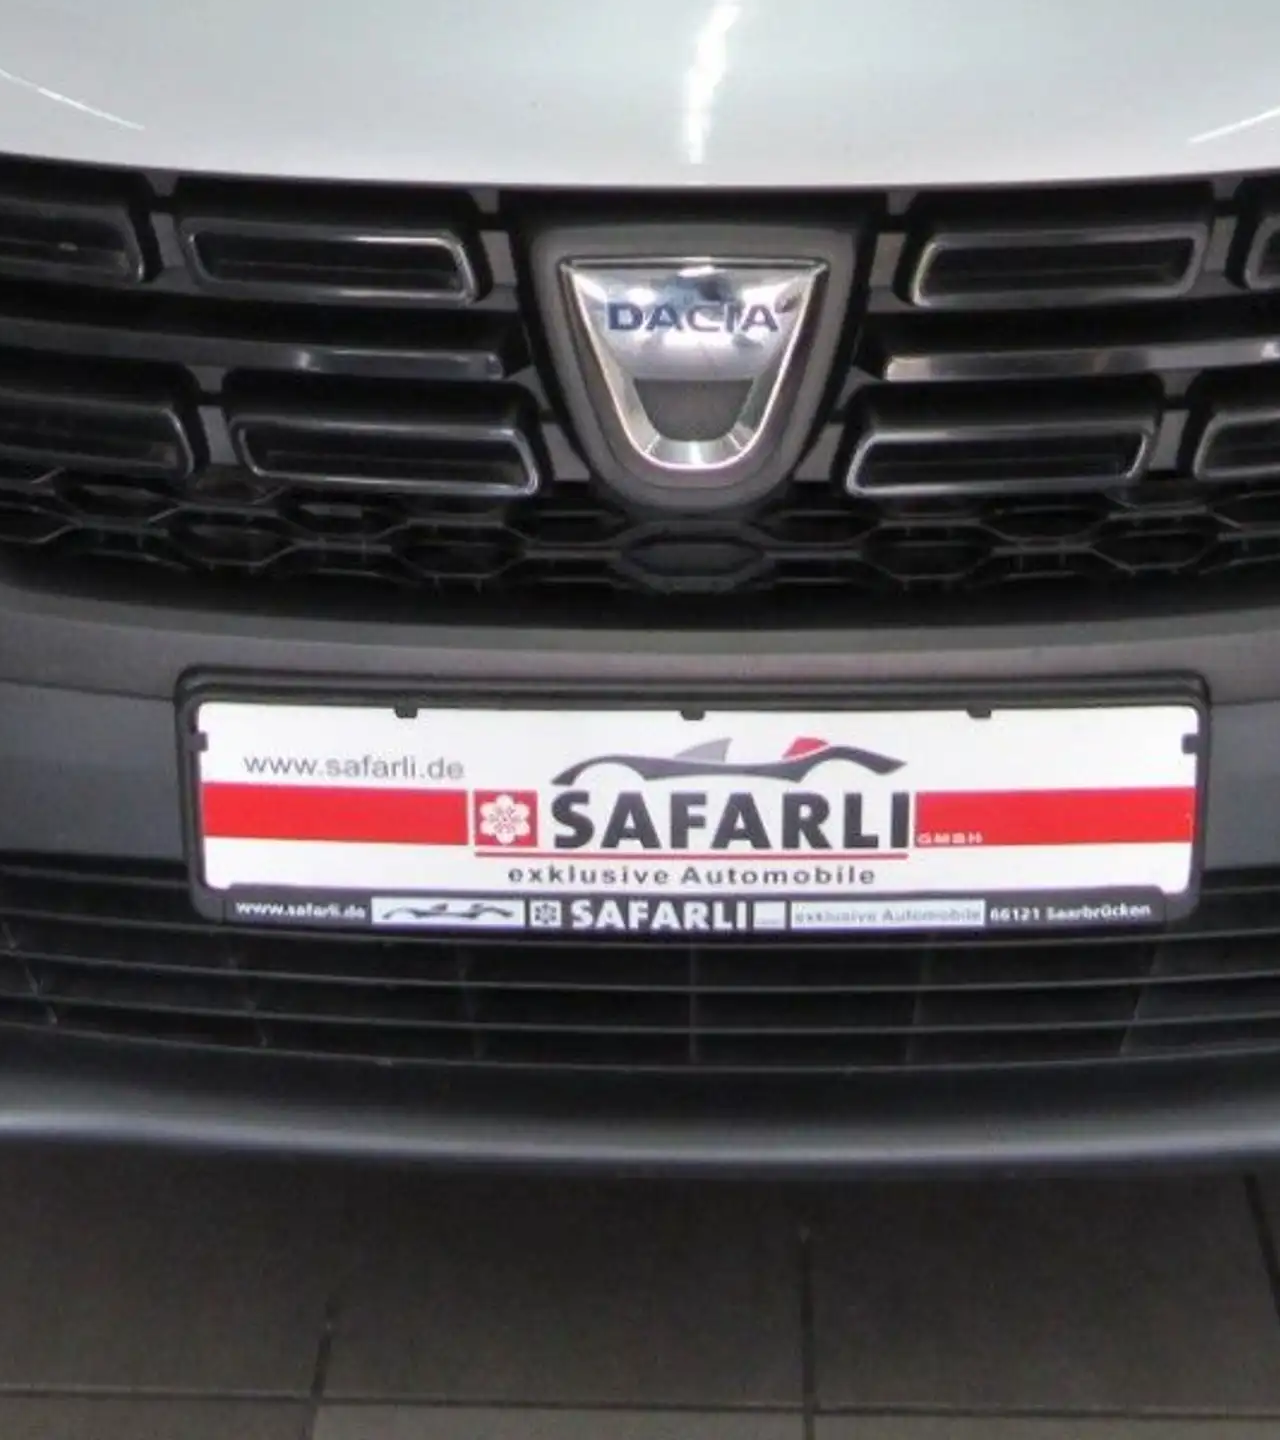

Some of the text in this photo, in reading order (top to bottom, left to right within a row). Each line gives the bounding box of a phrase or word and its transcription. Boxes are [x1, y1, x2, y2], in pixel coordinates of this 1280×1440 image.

[606, 301, 778, 333] DACIA
[243, 754, 466, 781] www.safarli.de
[551, 789, 910, 850] SAFARLI
[508, 863, 877, 887] exklusive Automobile
[571, 899, 748, 930] SAFARLI
